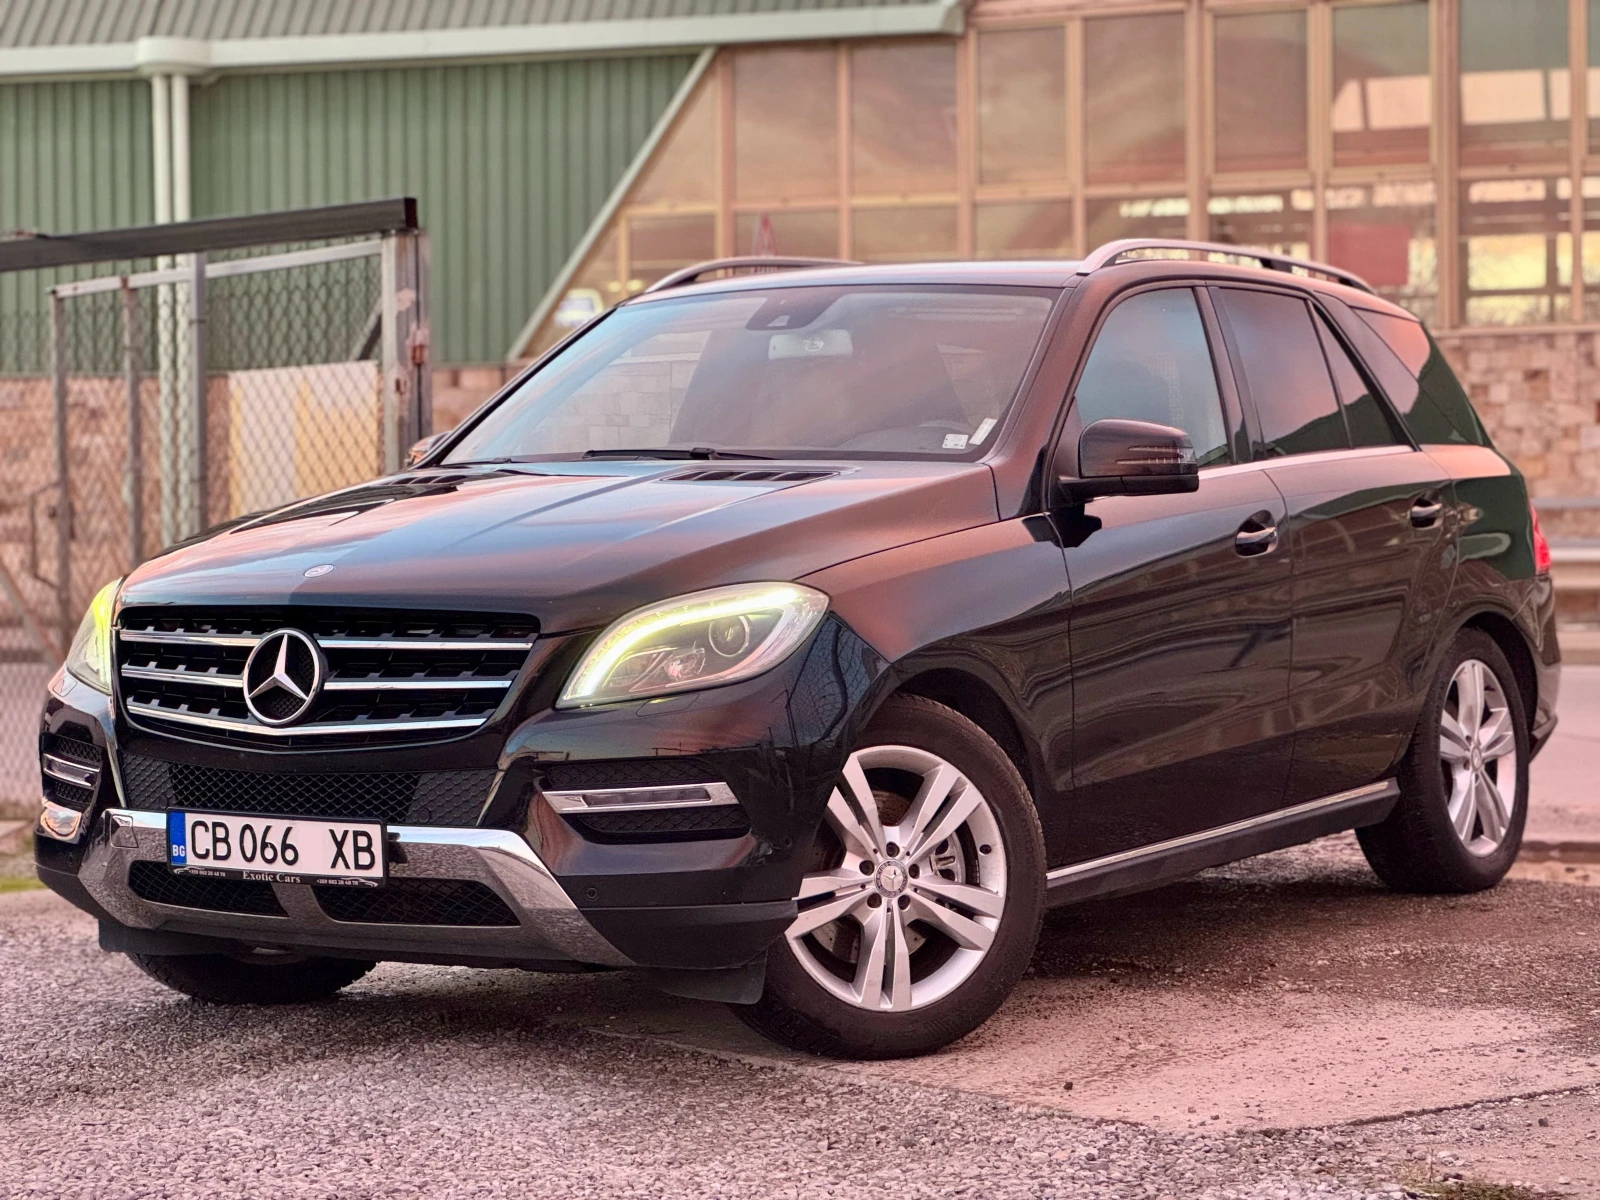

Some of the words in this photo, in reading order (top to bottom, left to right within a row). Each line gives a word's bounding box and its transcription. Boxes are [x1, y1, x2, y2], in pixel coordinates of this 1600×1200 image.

[172, 845, 185, 857] BG
[191, 820, 231, 861] CB
[239, 823, 299, 866] 066
[328, 828, 375, 870] XB
[242, 870, 274, 882] Exotic
[276, 872, 301, 884] Cars
